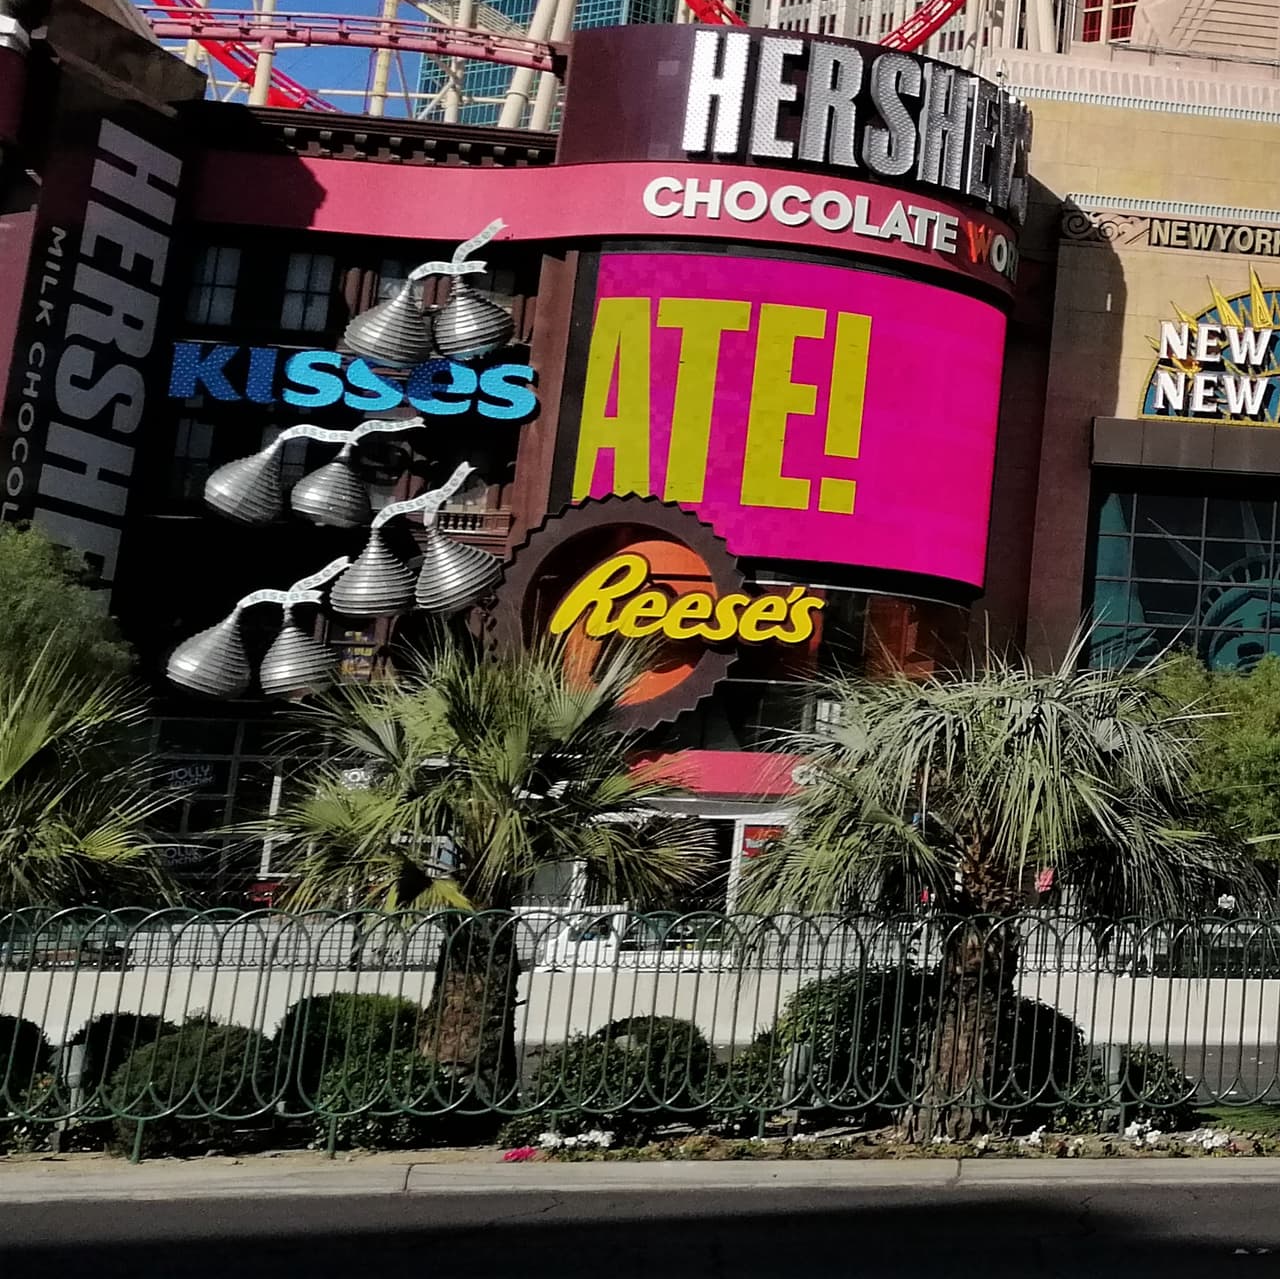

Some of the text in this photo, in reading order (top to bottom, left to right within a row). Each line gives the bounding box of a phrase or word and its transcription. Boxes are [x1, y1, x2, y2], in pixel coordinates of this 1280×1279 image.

[642, 176, 1018, 285] CHOCOLATE WOR
[1, 225, 67, 521] MILK CHOCOL
[33, 117, 184, 615] HERSHE
[1153, 370, 1269, 416] NEW
[1158, 320, 1272, 366] NEW
[571, 296, 873, 515] ATE!
[549, 552, 827, 644] Reese's
